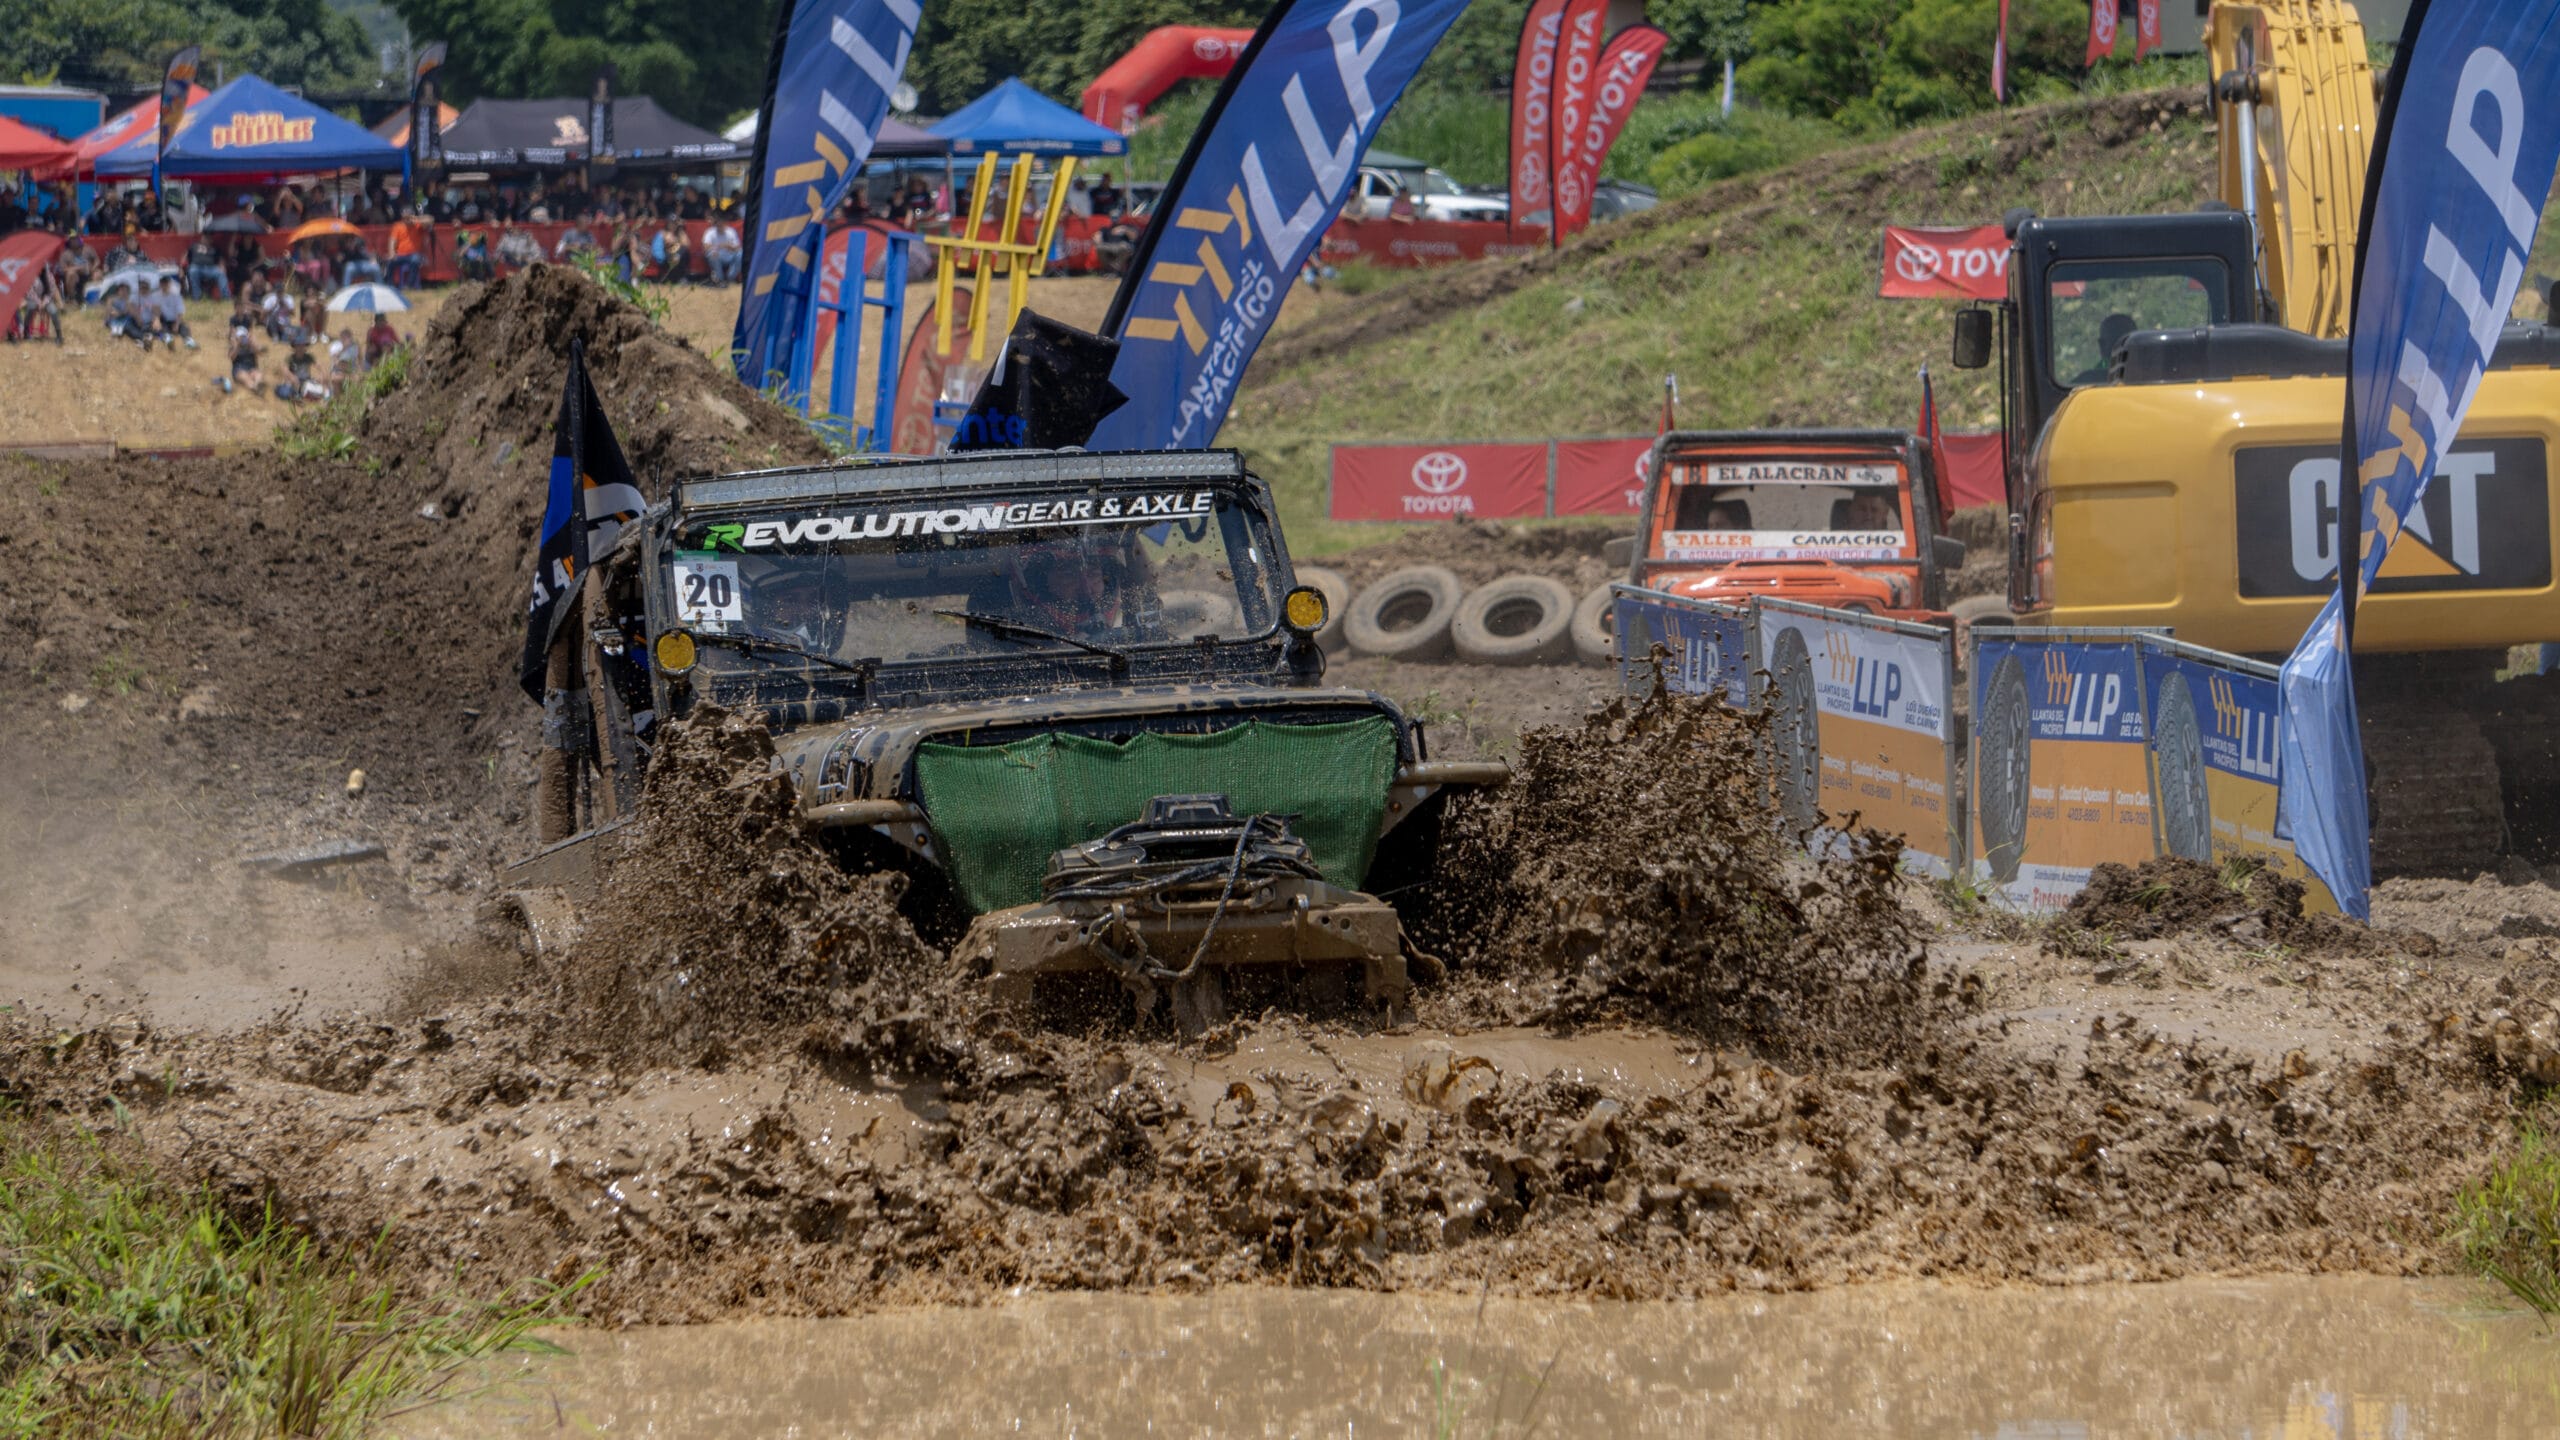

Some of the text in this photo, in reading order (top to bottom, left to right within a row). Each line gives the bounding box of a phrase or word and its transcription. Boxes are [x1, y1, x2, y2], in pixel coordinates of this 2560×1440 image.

[1523, 11, 1563, 148] TOYOTA
[1562, 8, 1598, 158] TOYOTA
[1240, 0, 1402, 273] LLP
[2398, 45, 2539, 452] LLP
[1401, 495, 1474, 513] TOYOTA
[1718, 465, 1744, 482] EL
[1749, 465, 1848, 482] ALACRAN
[702, 492, 1215, 556] REVOLUTION GEAR & AXLE
[1674, 533, 1898, 546] TALLER CAMACHO
[684, 573, 732, 608] 20
[1853, 656, 1902, 719] LLP
[2064, 672, 2121, 736] LLP
[2121, 711, 2133, 724] LOS
[2119, 724, 2132, 737] DEL
